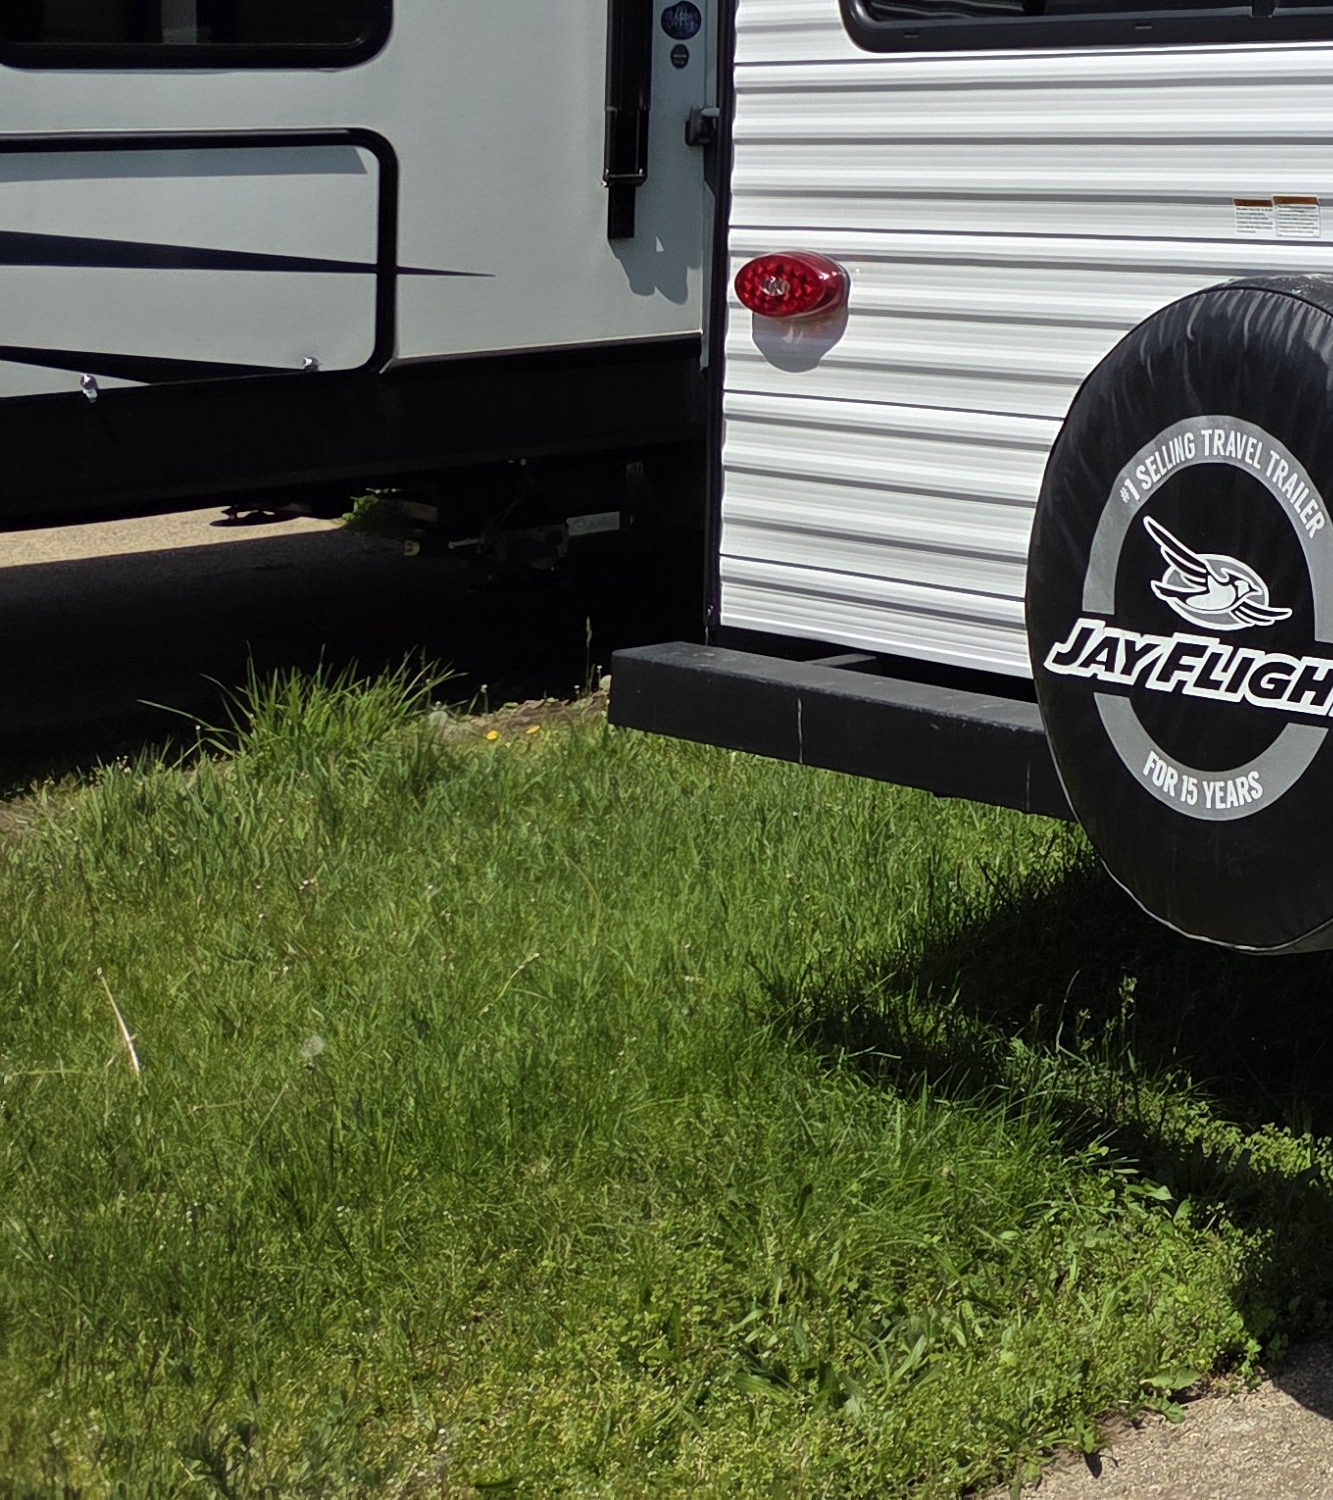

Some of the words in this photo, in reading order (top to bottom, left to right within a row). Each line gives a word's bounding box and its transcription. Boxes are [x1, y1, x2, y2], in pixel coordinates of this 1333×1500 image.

[1119, 476, 1140, 504] #1
[1137, 430, 1197, 491] SELLING
[1201, 429, 1264, 471] TRAVEL
[1266, 455, 1326, 539] TRAILER
[1141, 750, 1179, 799] FOR
[1179, 774, 1199, 805] 15
[1201, 770, 1264, 810] YEARS
